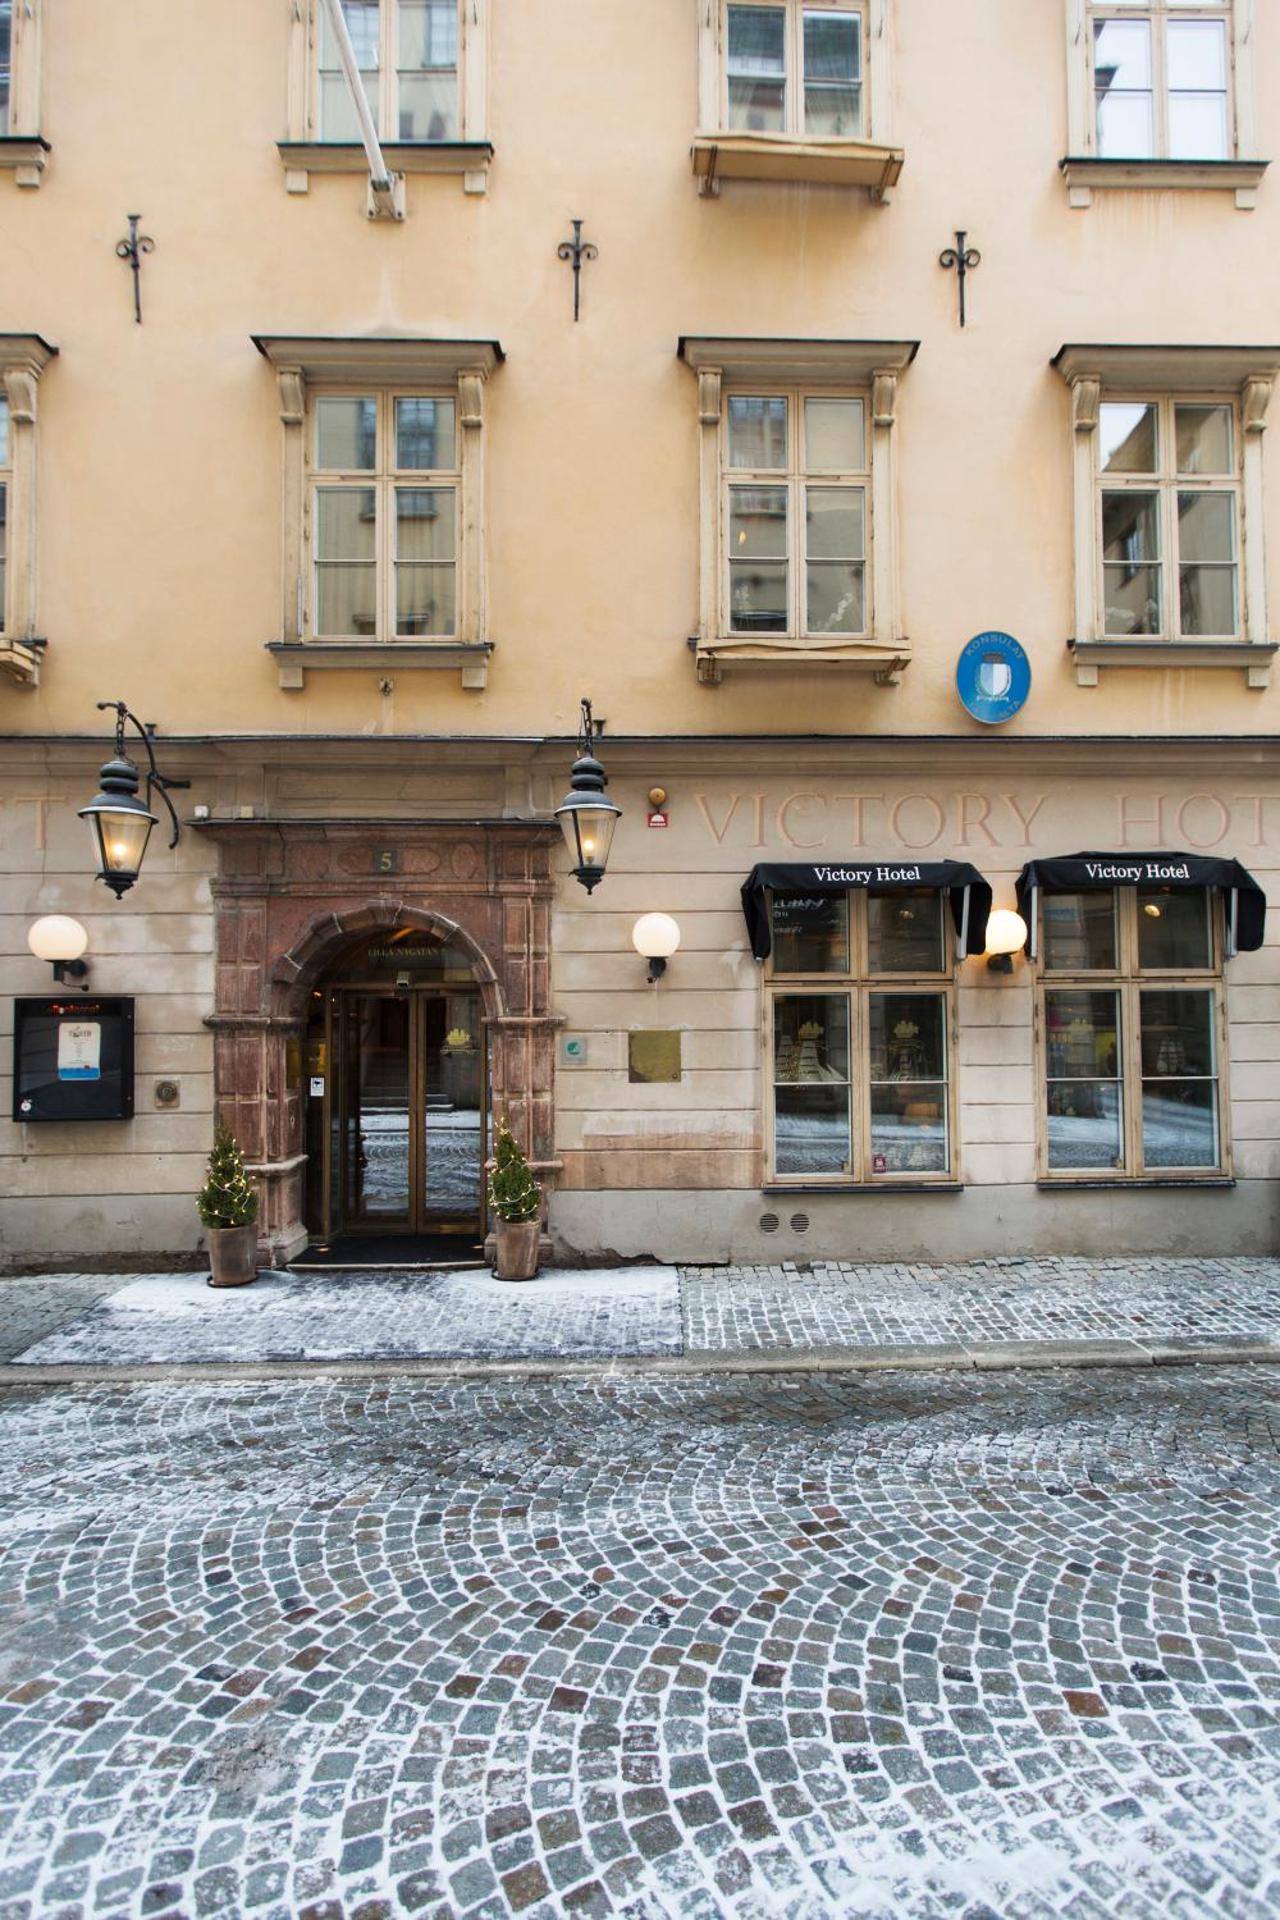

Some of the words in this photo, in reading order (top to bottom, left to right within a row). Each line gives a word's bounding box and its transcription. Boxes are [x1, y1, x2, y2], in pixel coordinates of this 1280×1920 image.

[695, 792, 1047, 849] VICTORY
[381, 852, 392, 870] 5
[814, 867, 873, 884] Victory
[876, 866, 921, 881] Hotel
[1085, 863, 1142, 881] Victory
[1146, 864, 1190, 878] Hotel
